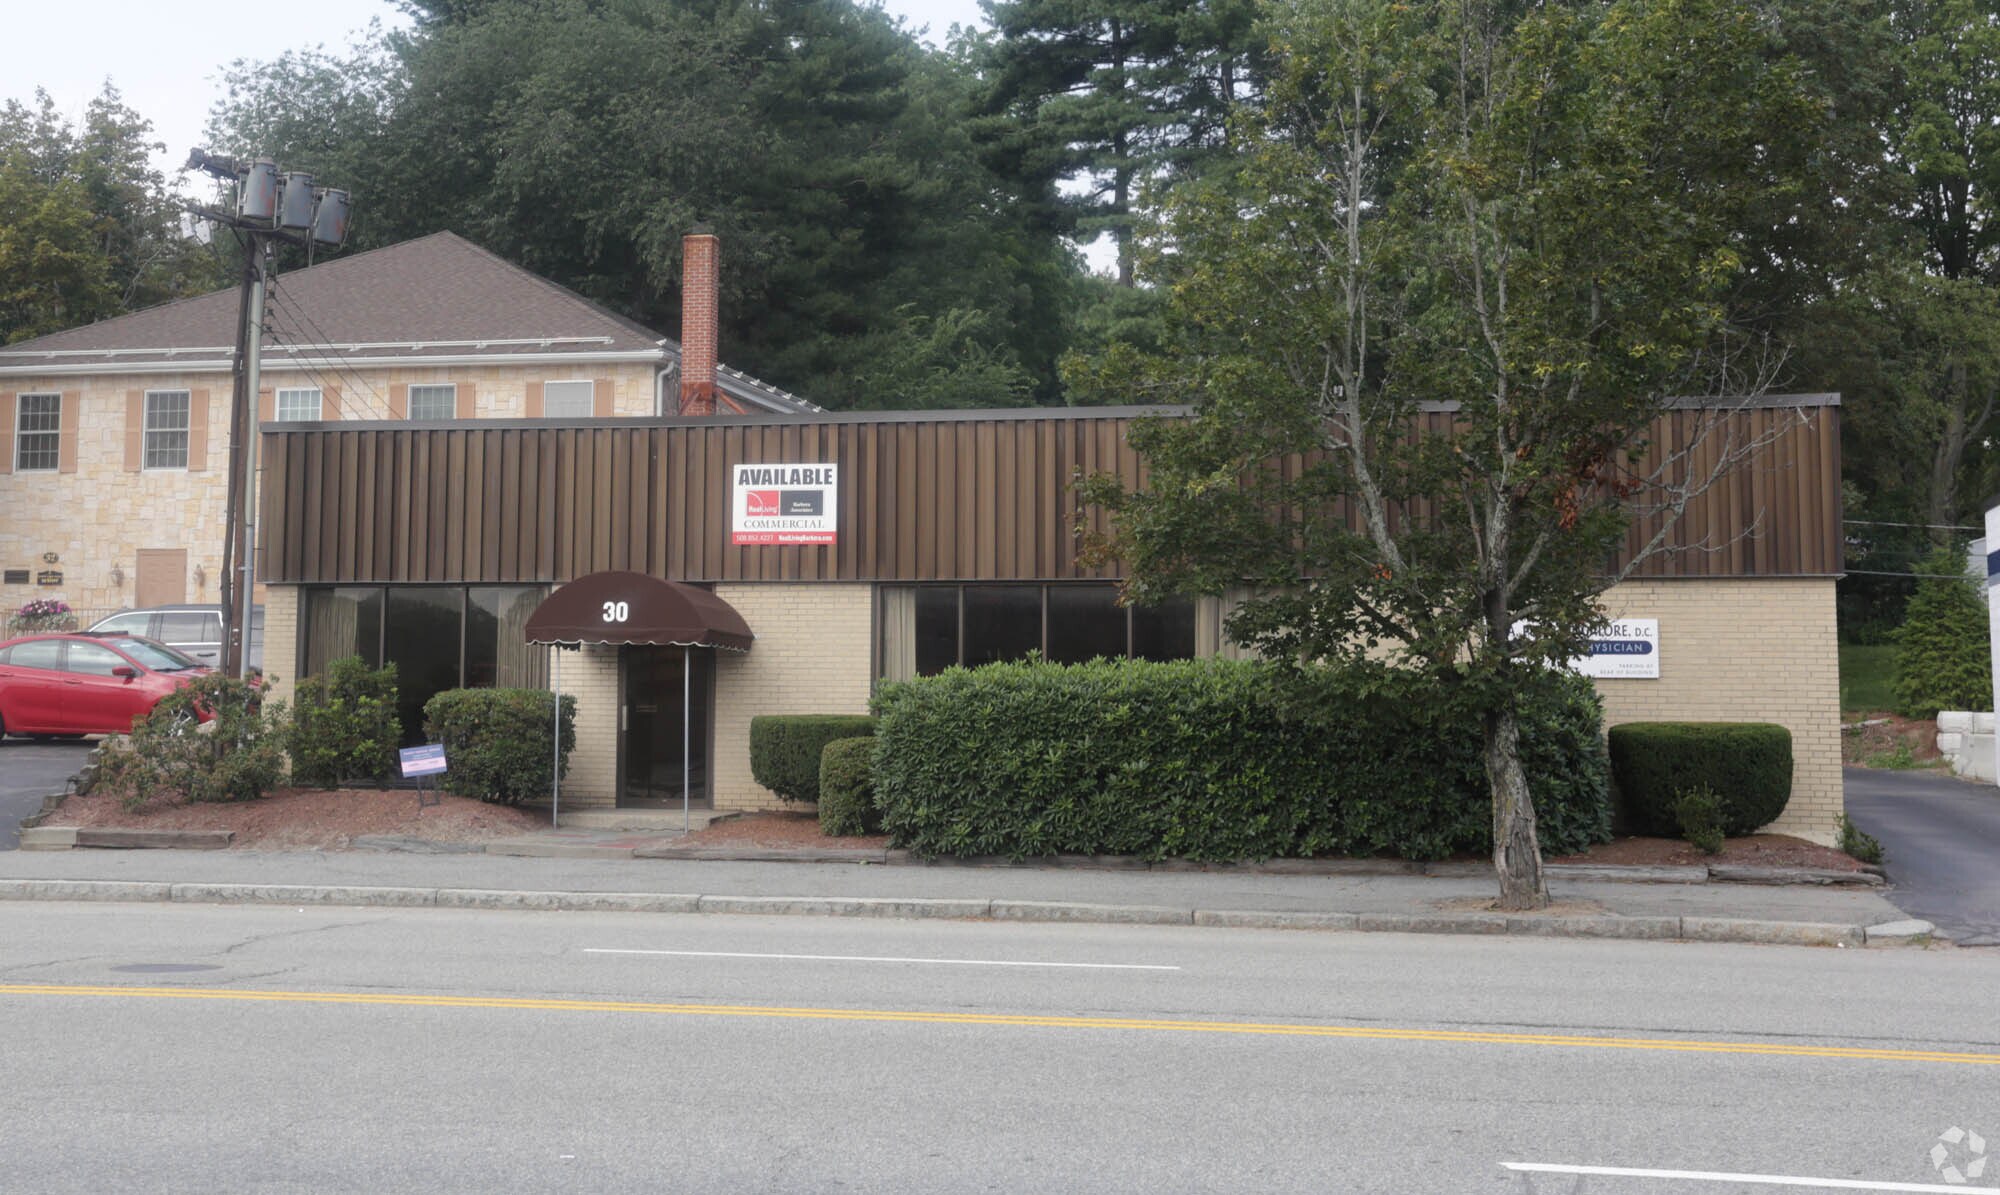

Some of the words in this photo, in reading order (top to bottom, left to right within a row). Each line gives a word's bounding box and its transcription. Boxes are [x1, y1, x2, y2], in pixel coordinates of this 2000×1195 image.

[739, 469, 832, 485] AVAILABLE
[743, 519, 825, 529] COMMERCIAL
[603, 601, 628, 622] 30
[1635, 627, 1653, 637] D.C.
[1586, 643, 1643, 652] HYSICIAN
